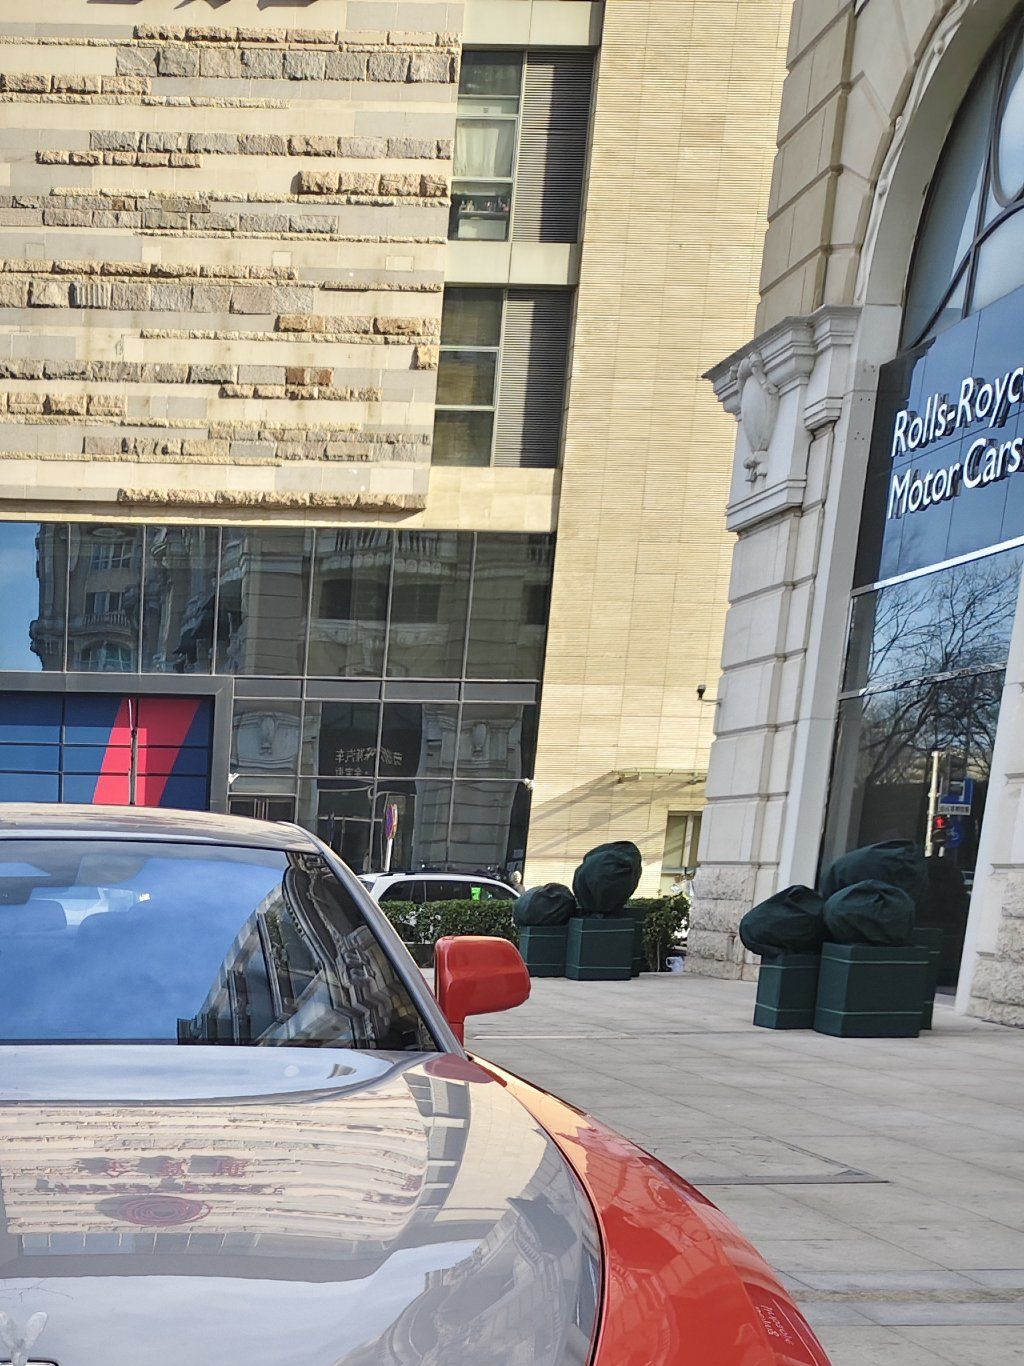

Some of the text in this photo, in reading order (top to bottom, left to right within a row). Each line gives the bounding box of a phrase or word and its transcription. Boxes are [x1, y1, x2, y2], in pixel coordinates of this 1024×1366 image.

[891, 367, 1024, 457] Rolls-Royc
[888, 437, 1023, 519] Motor Cars
